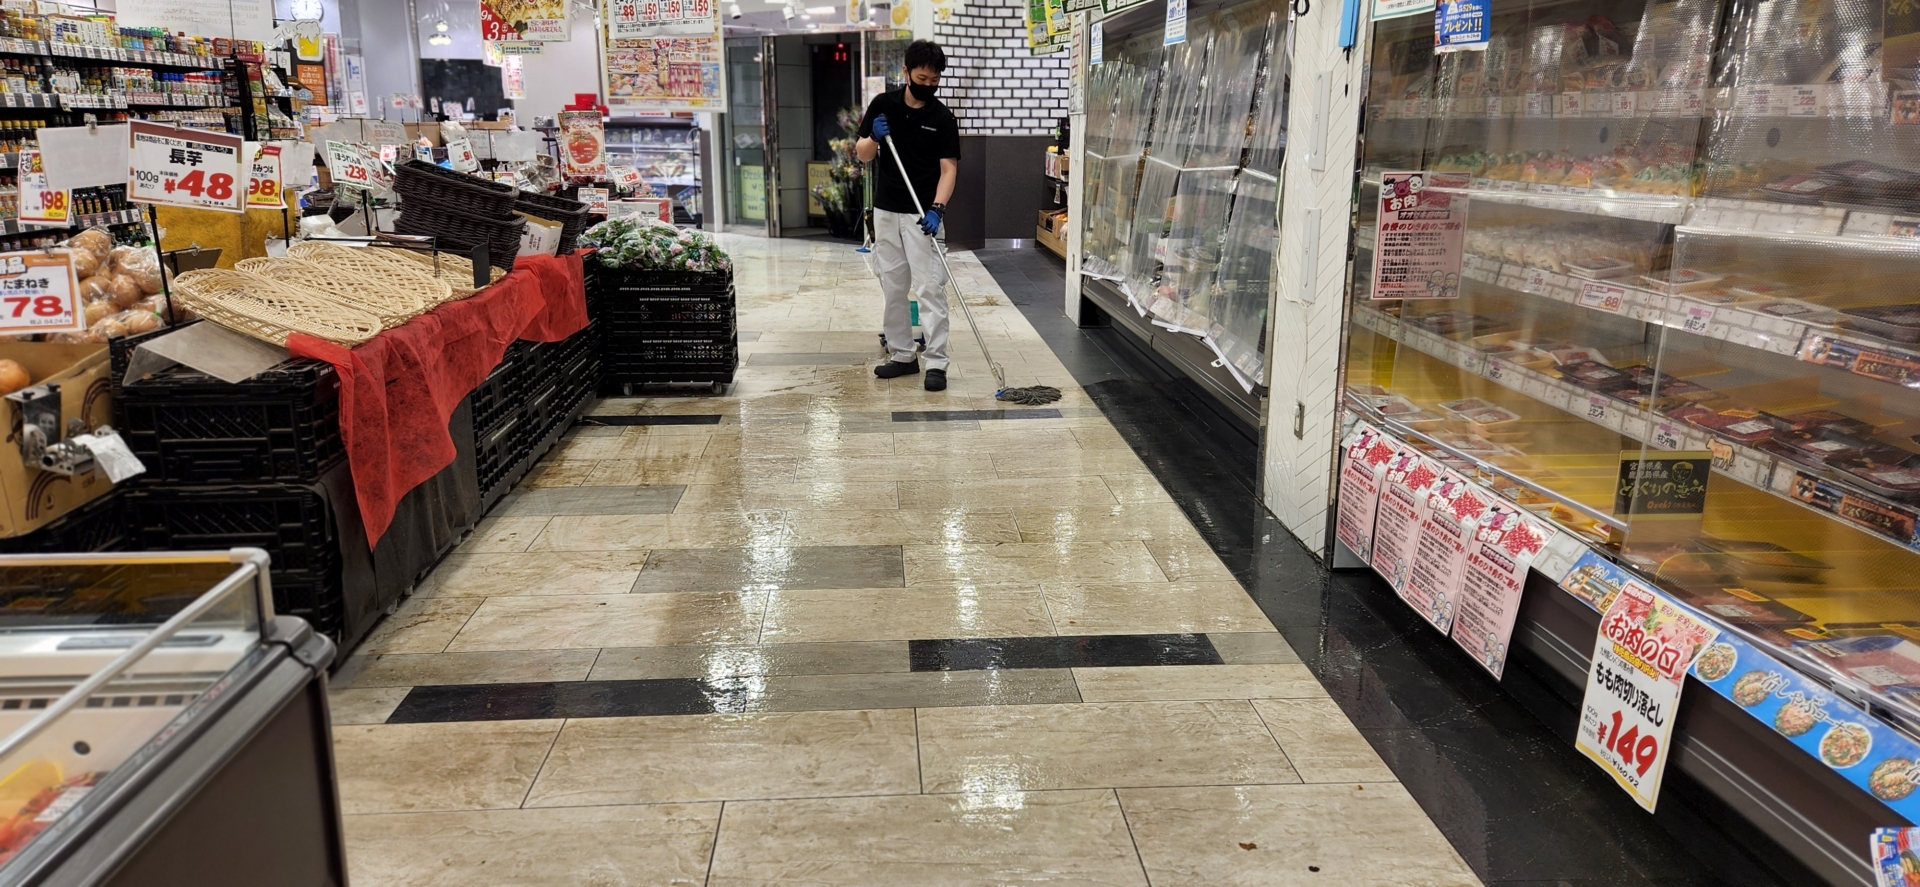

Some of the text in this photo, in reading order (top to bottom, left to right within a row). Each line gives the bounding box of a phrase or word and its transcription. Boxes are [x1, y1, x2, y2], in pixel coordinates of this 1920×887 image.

[487, 22, 499, 40] 3
[169, 148, 203, 166] 長芋
[136, 170, 159, 183] 100g
[39, 191, 63, 210] 198
[1390, 195, 1418, 210] お肉
[1382, 223, 1461, 231] 自慢のひき肉のご紹介
[3, 278, 49, 289] たまねぎ
[4, 296, 63, 317] 78
[1351, 448, 1364, 459] お肉
[1387, 470, 1406, 483] お肉
[1619, 478, 1705, 499] どんぐりの恵み
[1429, 493, 1450, 511] お肉
[1477, 527, 1500, 544] お肉
[1467, 552, 1520, 593] 自慢のひき肉のご紹介
[1607, 613, 1682, 676] お肉の日
[1595, 661, 1664, 728] もも肉切り落とし
[1761, 671, 1854, 736] 冷しゃぶコーナー
